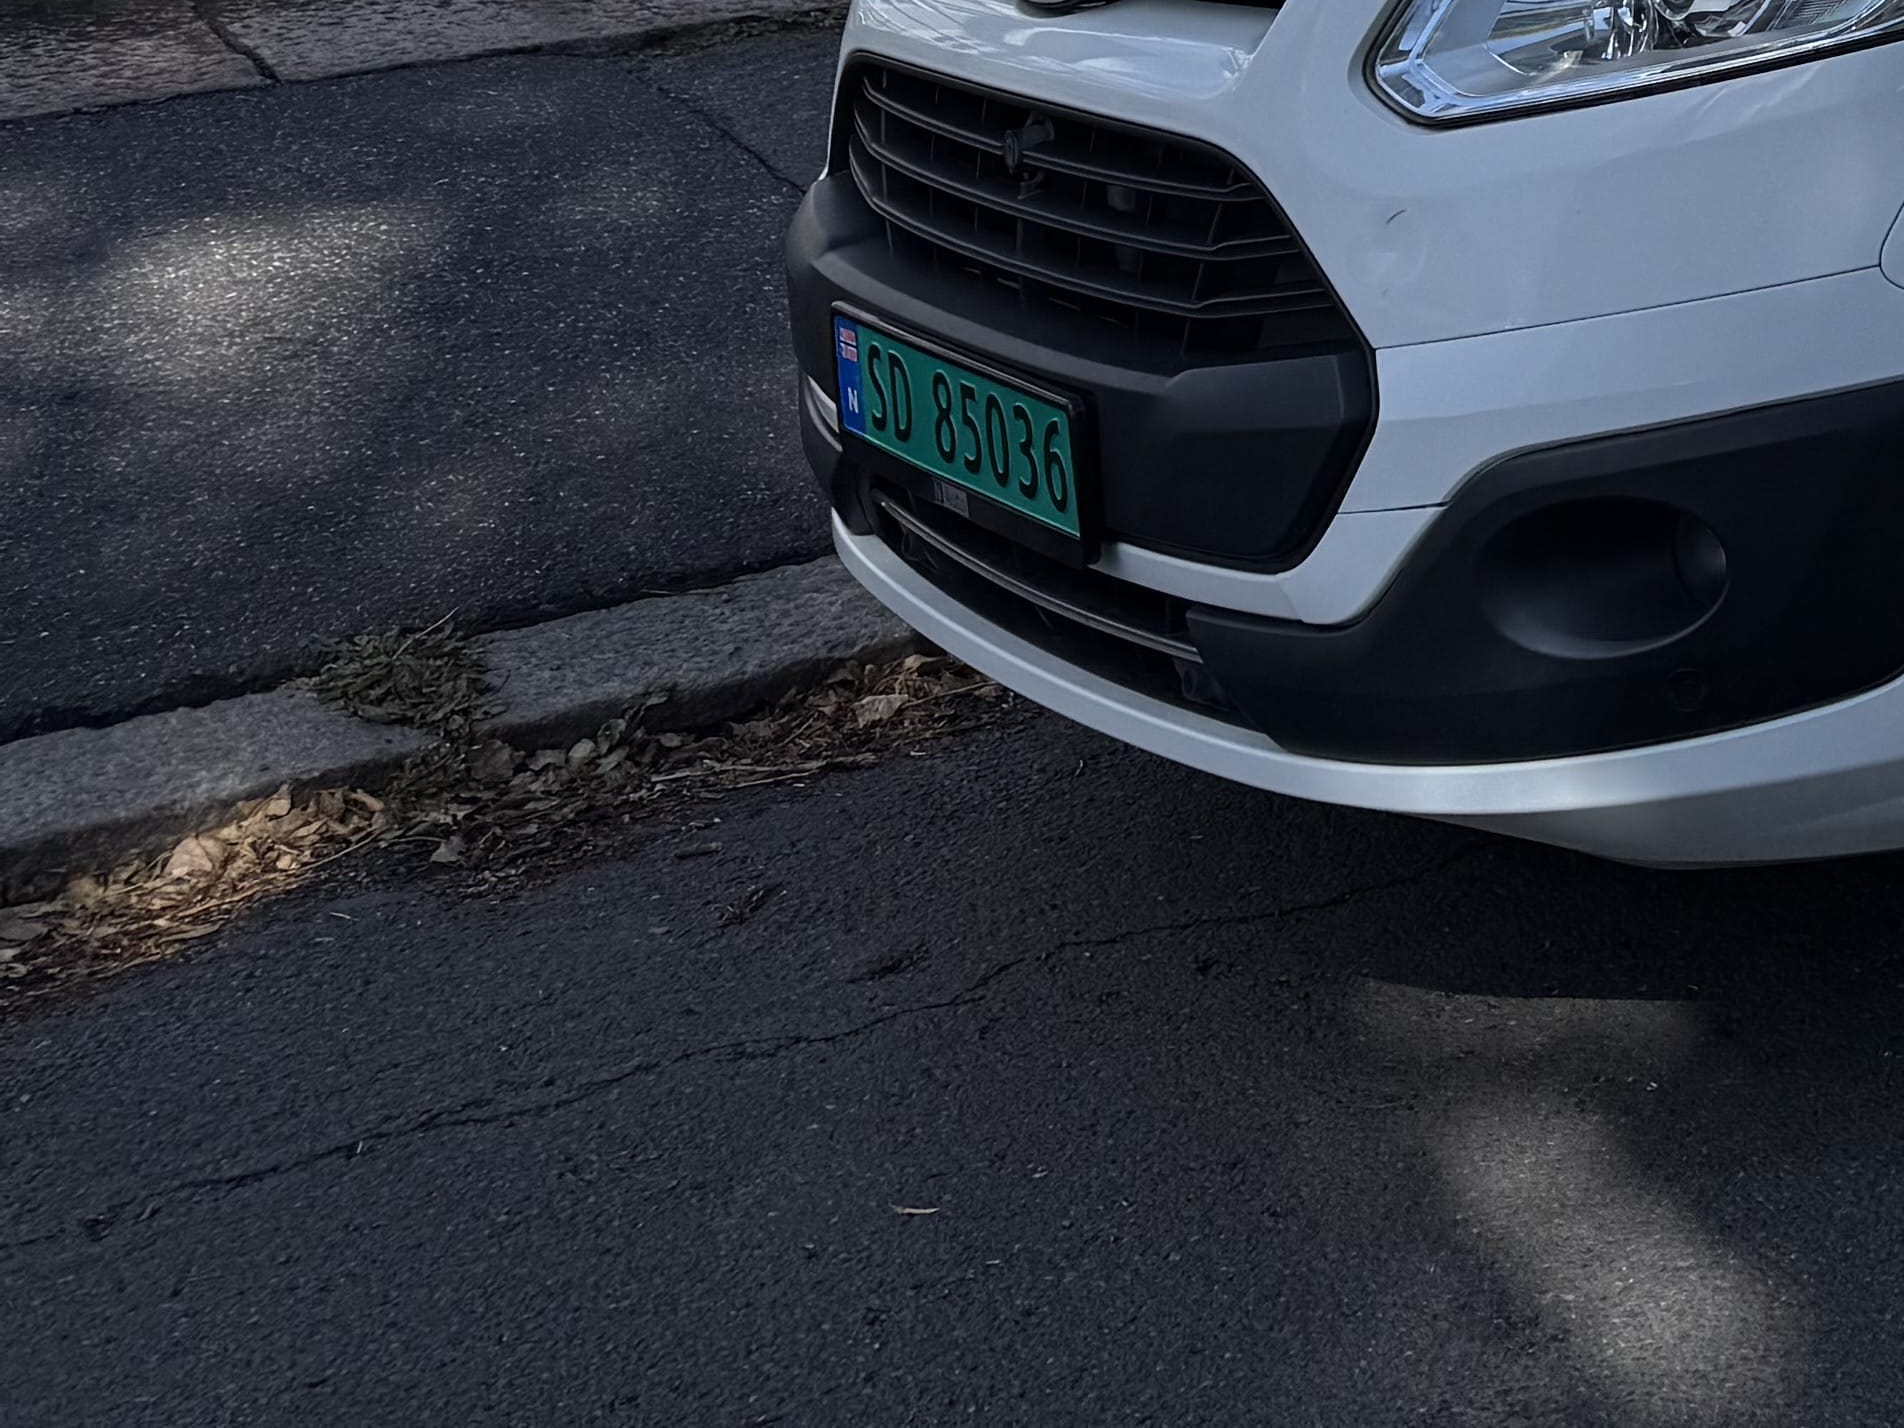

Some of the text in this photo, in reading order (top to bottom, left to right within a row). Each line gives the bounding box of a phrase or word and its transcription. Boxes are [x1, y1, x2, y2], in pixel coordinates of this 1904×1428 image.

[848, 387, 859, 414] N
[867, 342, 1069, 514] SD 85036
